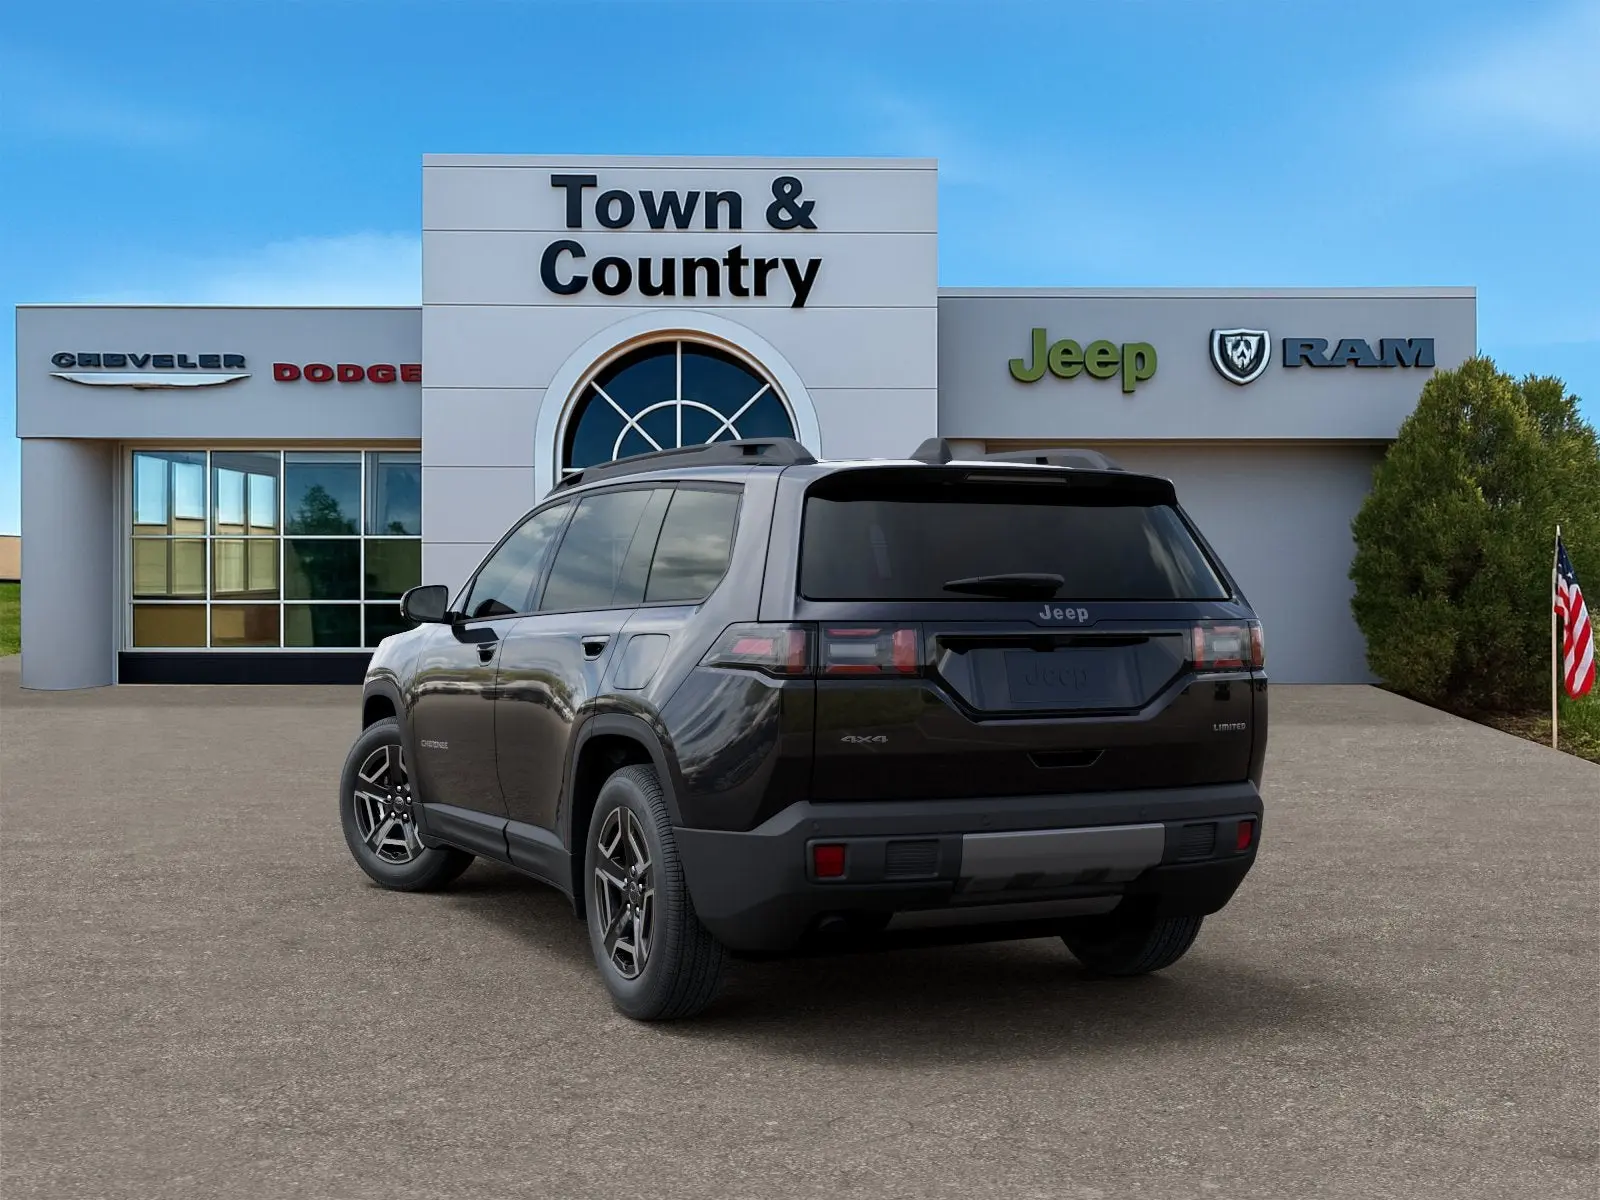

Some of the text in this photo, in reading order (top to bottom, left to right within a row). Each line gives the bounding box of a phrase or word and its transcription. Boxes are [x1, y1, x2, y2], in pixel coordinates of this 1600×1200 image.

[551, 174, 818, 230] Town &
[540, 239, 822, 308] Country
[1009, 328, 1157, 393] Jeep
[1283, 337, 1436, 368] RAM
[273, 363, 422, 383] DODGE
[1039, 604, 1089, 622] Jeep
[1025, 660, 1088, 691] Jeep
[1213, 722, 1246, 731] LIMITED
